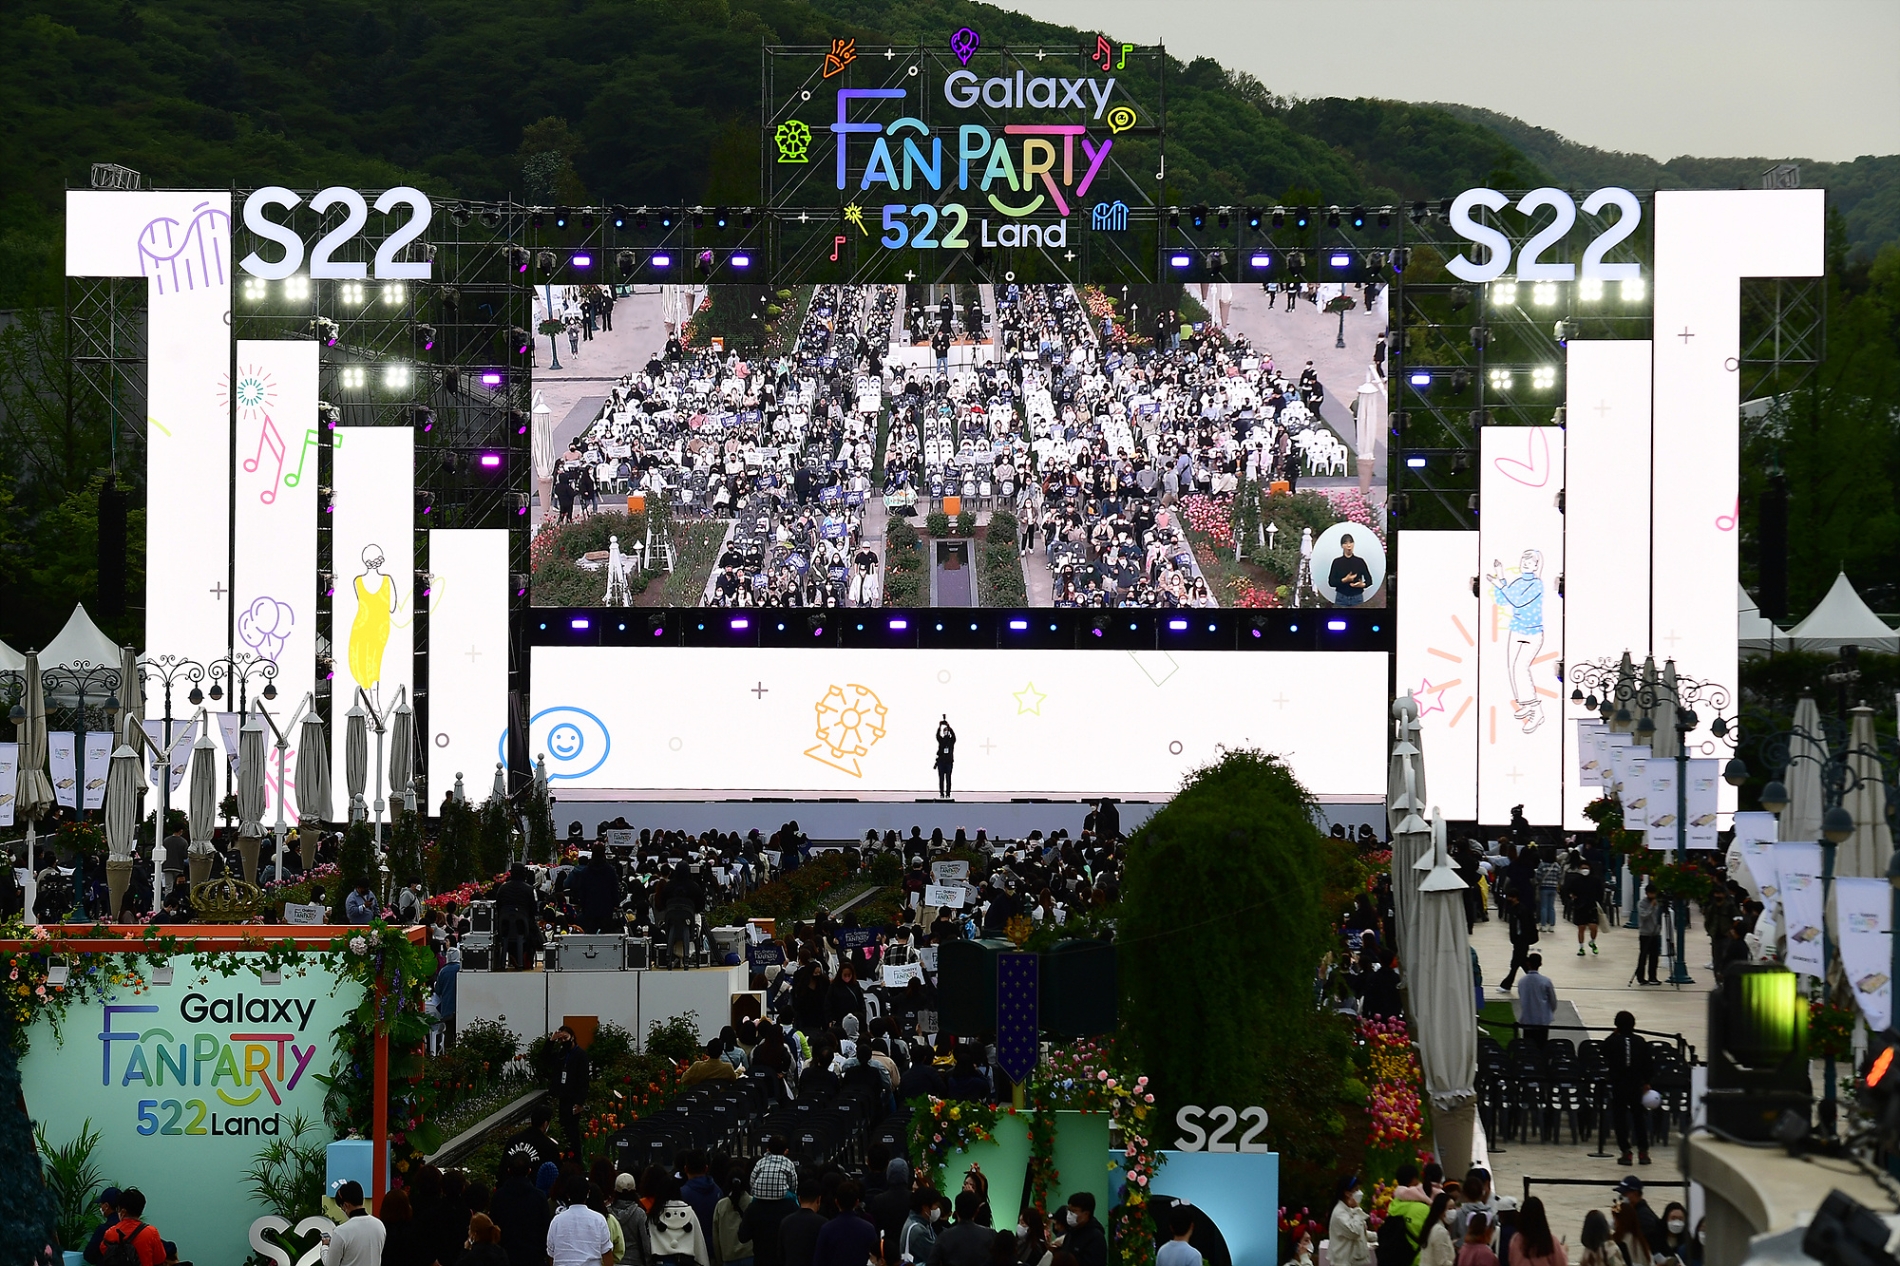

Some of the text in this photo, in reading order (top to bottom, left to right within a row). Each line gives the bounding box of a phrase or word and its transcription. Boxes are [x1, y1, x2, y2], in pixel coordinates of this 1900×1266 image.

[944, 69, 1116, 120] Galaxy
[238, 186, 433, 280] S22
[881, 203, 1067, 249] 522 Land
[1445, 186, 1642, 282] S22
[180, 992, 317, 1032] Galaxy
[136, 1099, 280, 1136] 522 Land
[1174, 1105, 1269, 1153] S22
[507, 1141, 541, 1163] MACHINE
